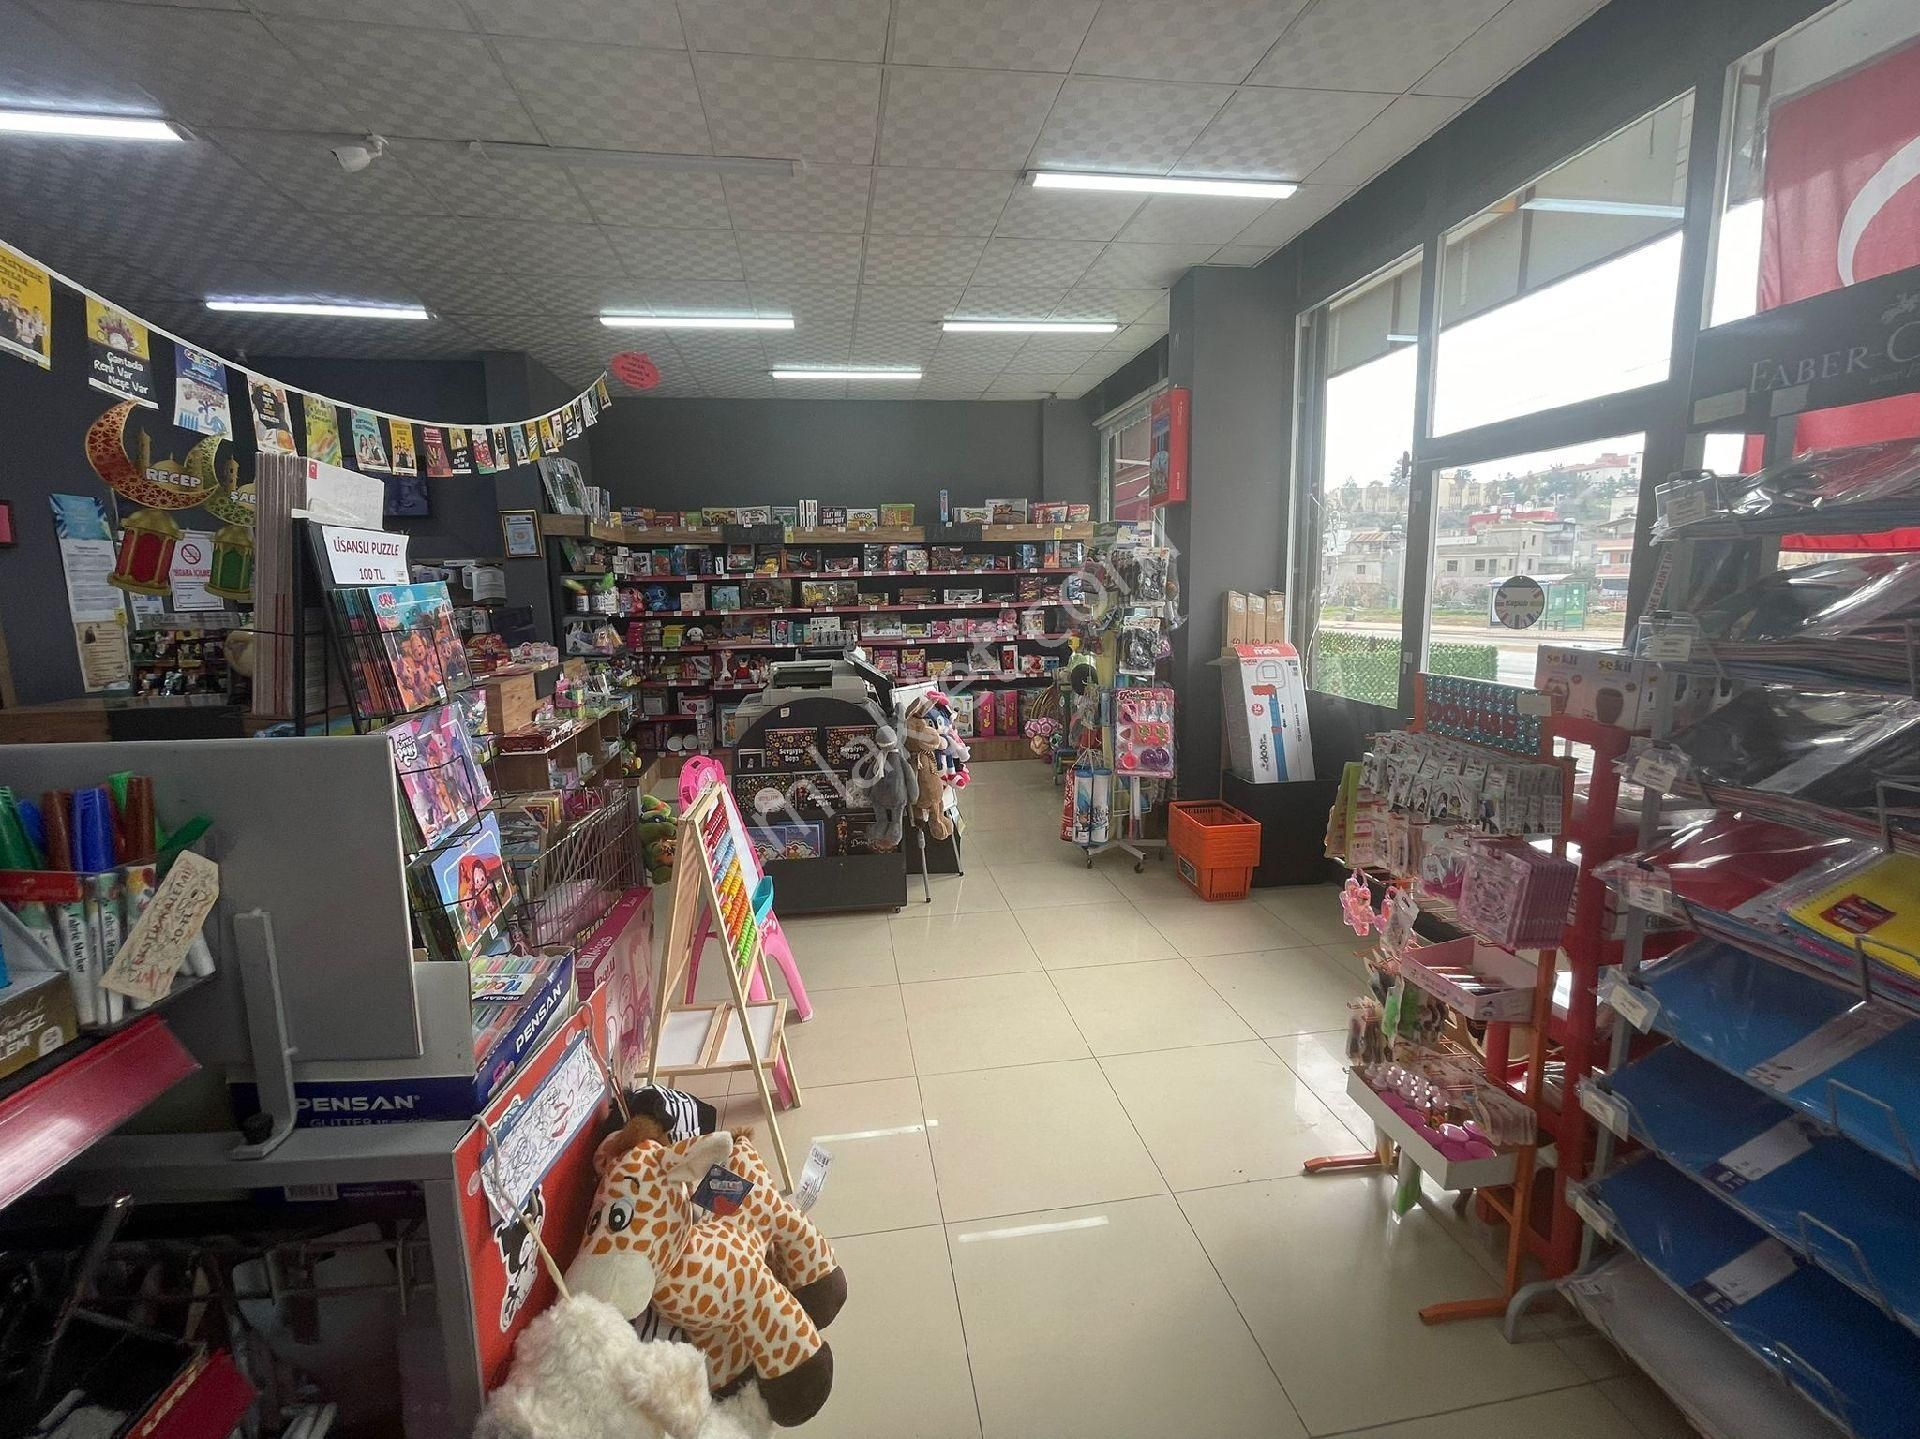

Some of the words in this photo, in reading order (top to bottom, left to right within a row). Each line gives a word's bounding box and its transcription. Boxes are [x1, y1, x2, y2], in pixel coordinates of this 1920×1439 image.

[117, 366, 133, 380] Var
[132, 381, 149, 394] Var
[145, 468, 201, 488] RECEP
[371, 542, 400, 556] PUZZLE
[359, 567, 374, 580] 100
[375, 568, 386, 580] TL
[515, 986, 562, 1053] PENSAN
[295, 1095, 414, 1112] PENSAN
